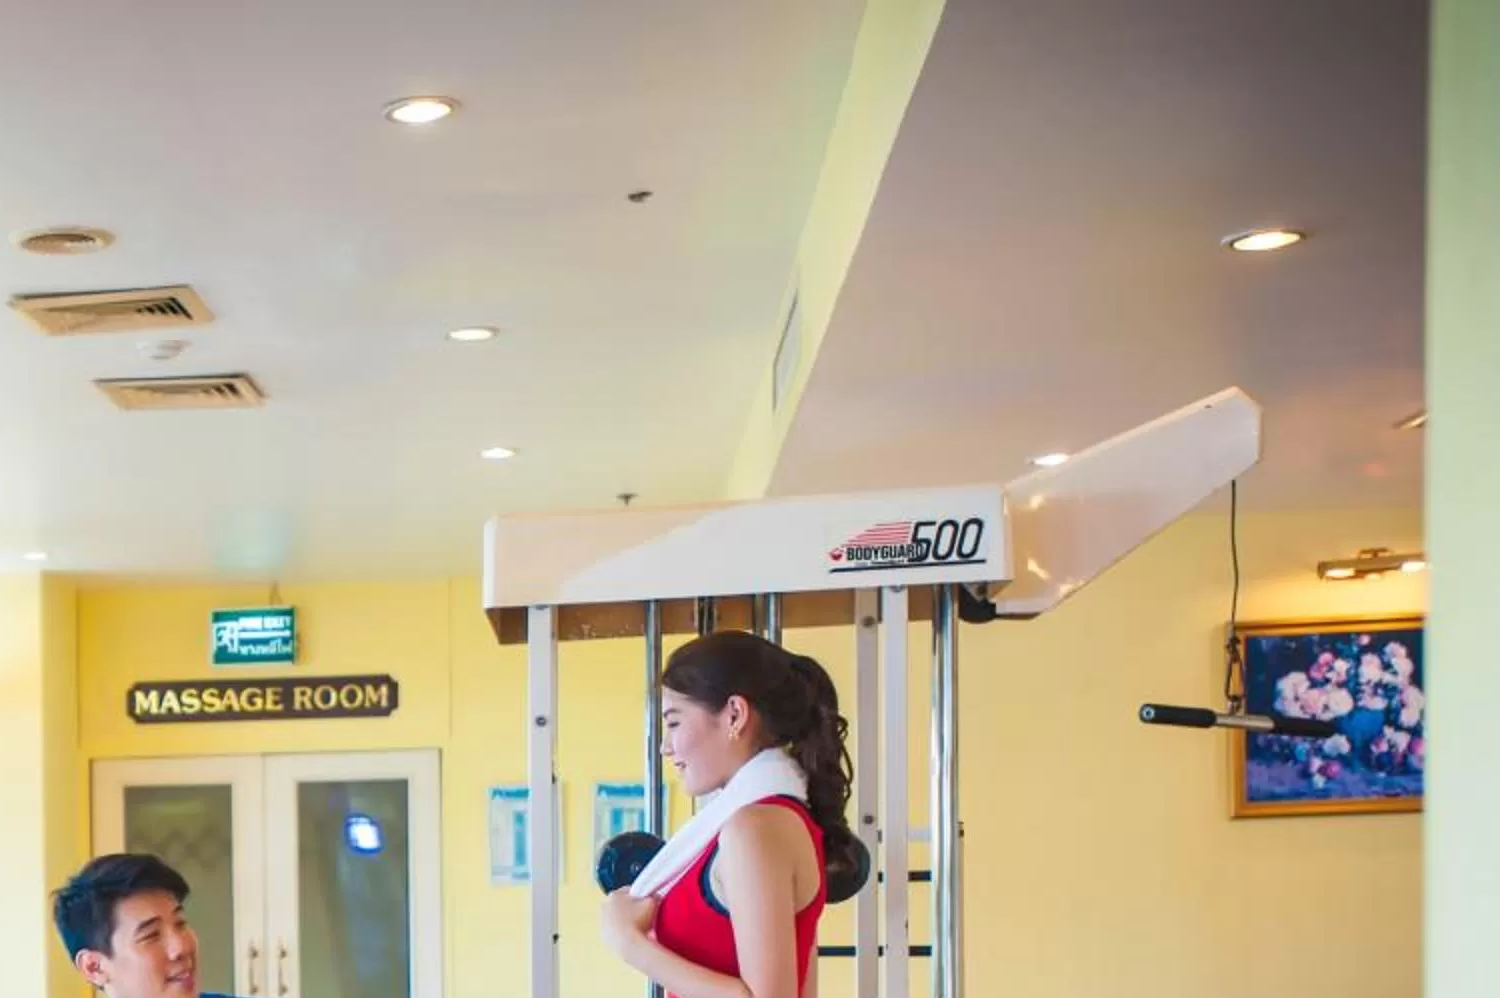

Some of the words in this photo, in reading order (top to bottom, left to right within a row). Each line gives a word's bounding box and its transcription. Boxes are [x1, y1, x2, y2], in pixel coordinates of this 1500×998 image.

[846, 543, 925, 561] BODYGUARD
[908, 517, 985, 563] 500
[135, 687, 283, 714] MASSAGE
[293, 684, 389, 710] ROOM
